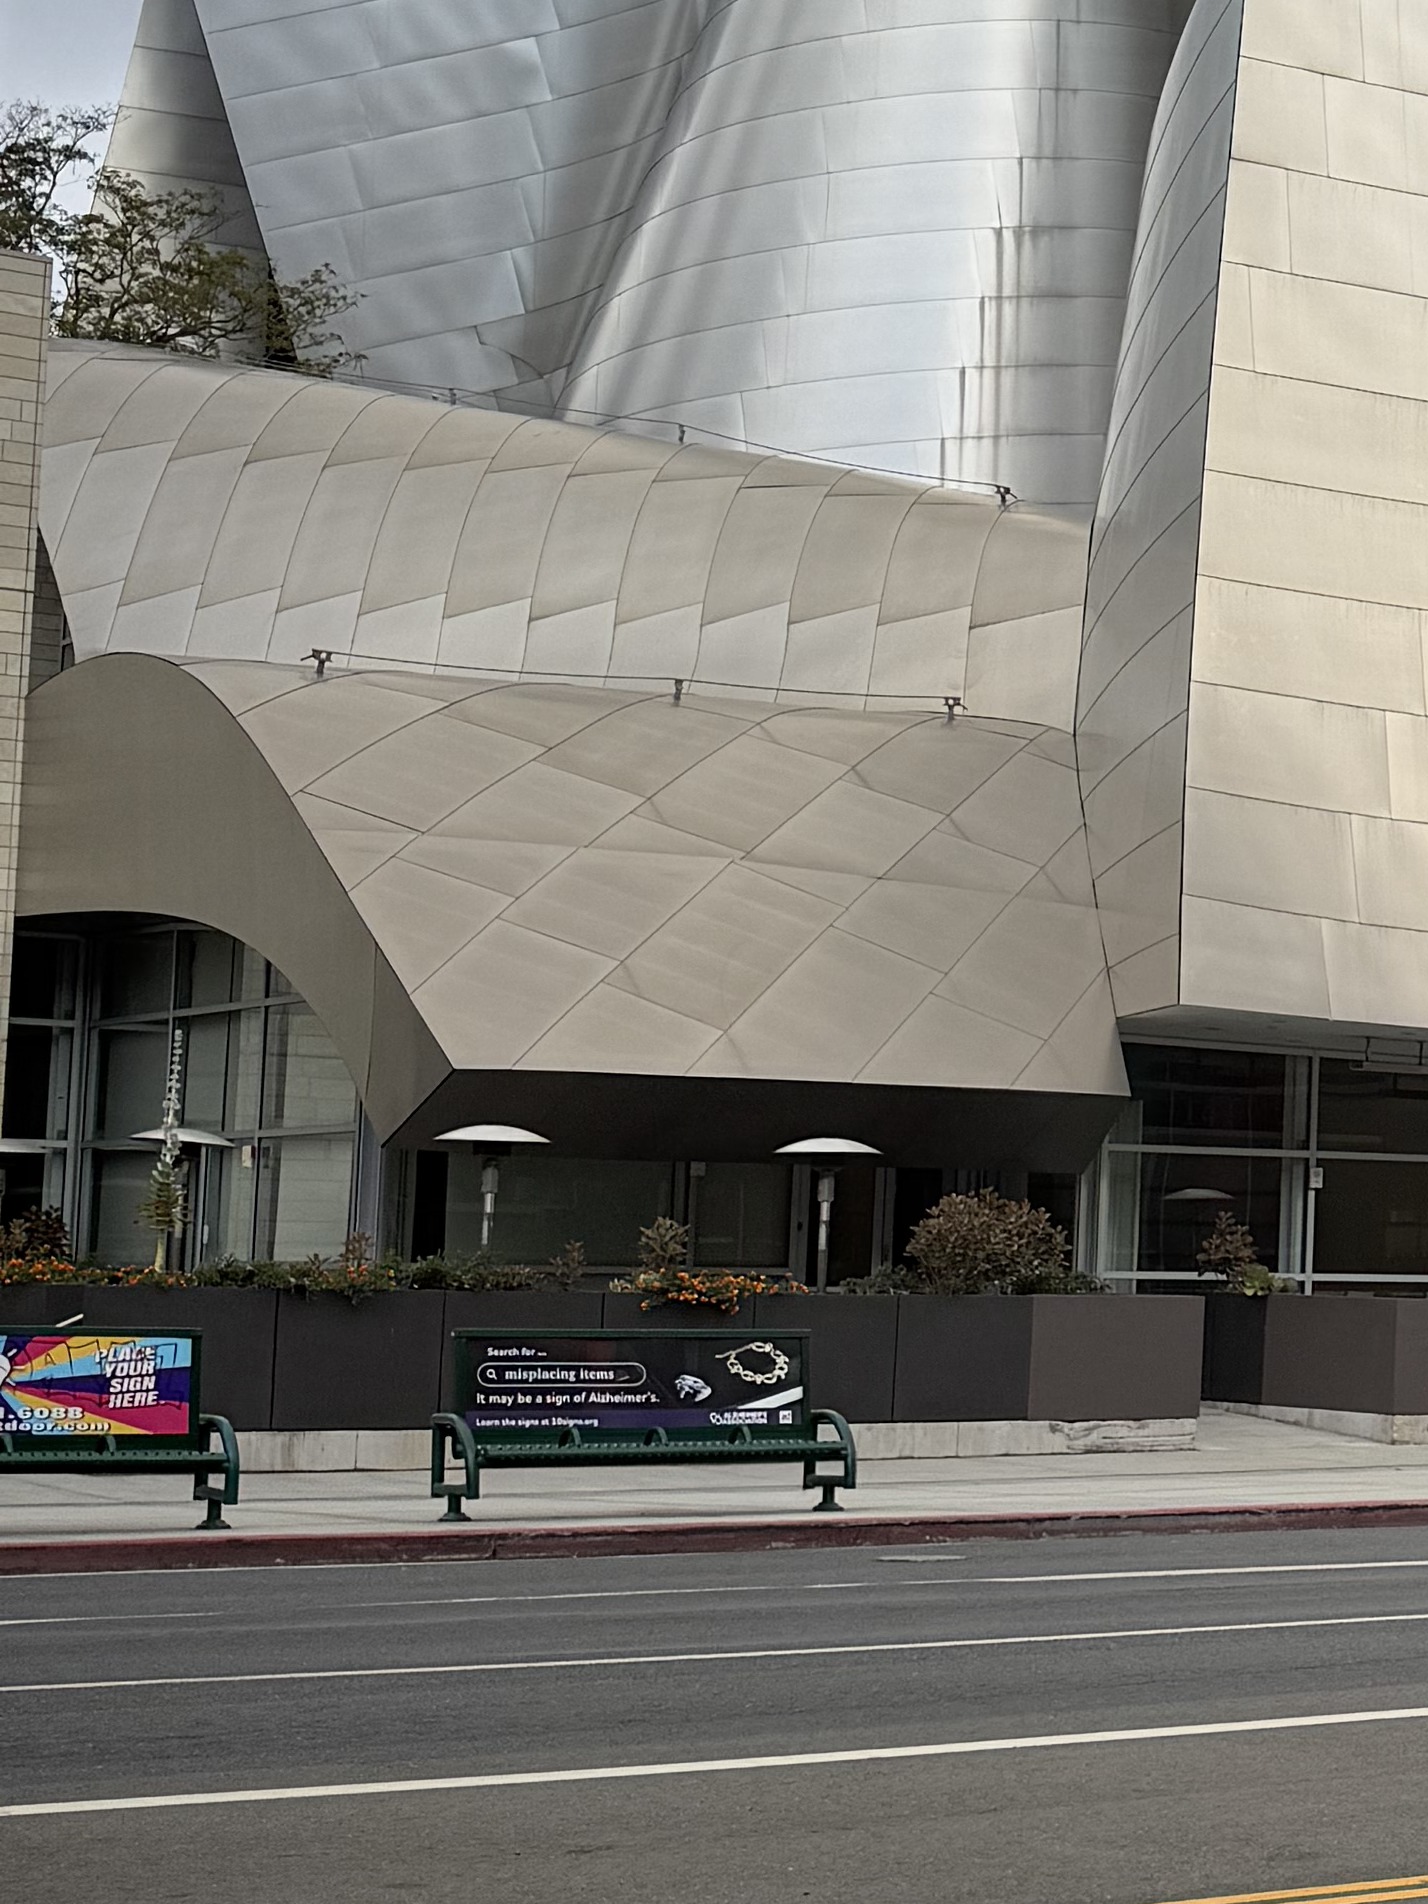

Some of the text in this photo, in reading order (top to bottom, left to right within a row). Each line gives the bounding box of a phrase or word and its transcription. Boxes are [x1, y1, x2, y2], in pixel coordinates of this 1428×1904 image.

[95, 1346, 156, 1363] PLACE
[487, 1347, 520, 1357] Search
[521, 1347, 536, 1357] for
[105, 1360, 156, 1378] YOUR
[504, 1367, 615, 1383] misplacing items
[109, 1375, 157, 1393] SIGN
[108, 1391, 166, 1409] HERE.
[476, 1392, 486, 1404] It
[488, 1395, 515, 1407] may
[517, 1392, 533, 1404] be
[536, 1395, 543, 1404] a
[545, 1391, 571, 1406] sign
[573, 1391, 587, 1404] of
[475, 1417, 500, 1427] Learn
[501, 1417, 516, 1427] the
[517, 1417, 540, 1429] signs
